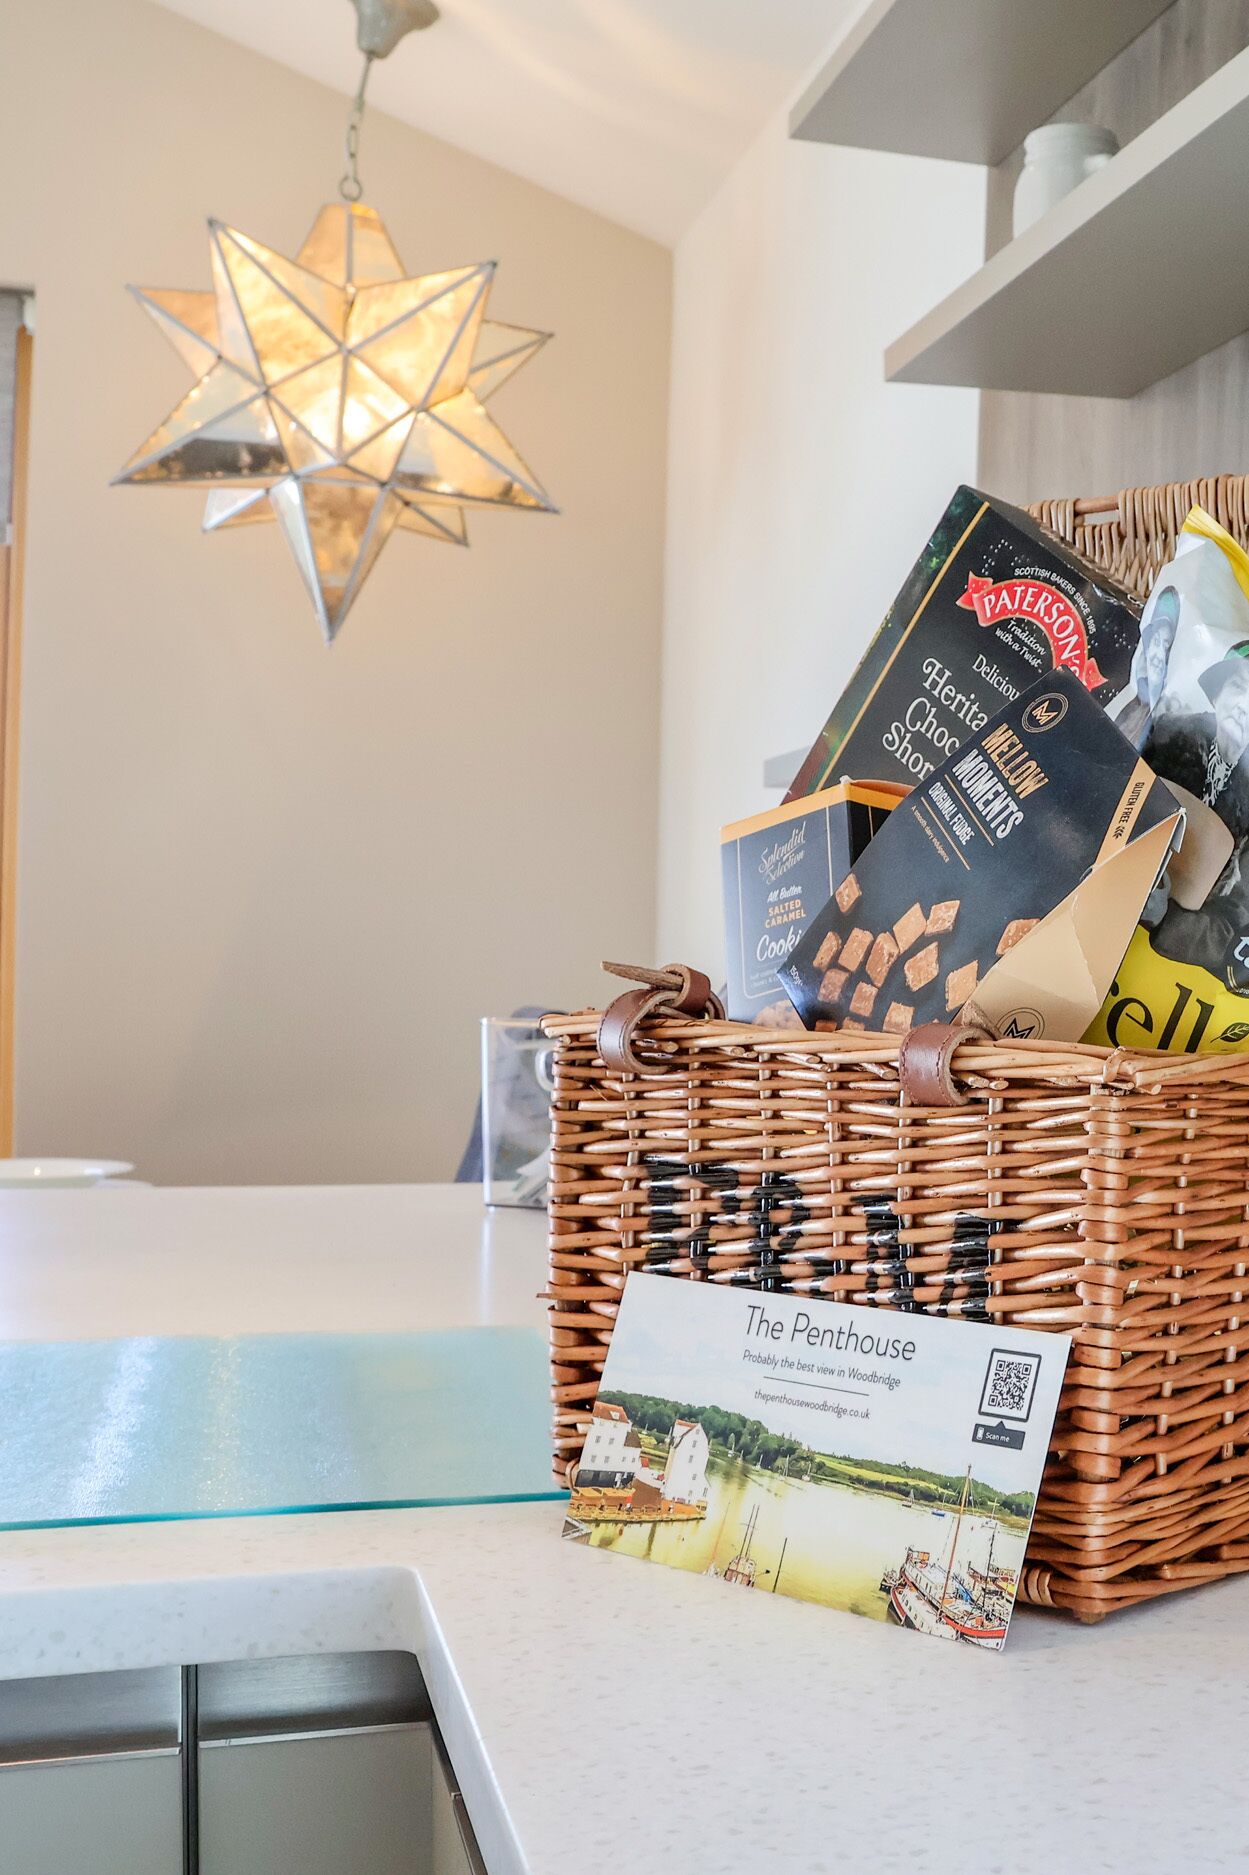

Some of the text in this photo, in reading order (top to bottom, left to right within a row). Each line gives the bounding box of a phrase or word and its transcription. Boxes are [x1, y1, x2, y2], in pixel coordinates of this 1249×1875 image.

[1014, 566, 1097, 635] SCOTTISH BAKERS SINCE 1895
[995, 627, 1014, 646] with
[1011, 642, 1022, 652] a
[1007, 619, 1046, 656] Tradition
[981, 722, 1050, 800] MELLOW
[928, 781, 975, 846] ORIGINAL FUDGE
[952, 748, 1025, 839] MOMENTS
[1118, 781, 1145, 824] GLUTEN FREE
[758, 820, 806, 874] Splendid
[767, 887, 779, 903] All
[768, 898, 802, 917] SALTED
[765, 907, 807, 929] CARAMEL
[1101, 980, 1215, 1053] ell
[746, 1304, 917, 1362] The Penthouse
[742, 1349, 901, 1391] Probably the best view in Woodbridge
[754, 1390, 871, 1420] thepenthousewoodbridge.co.uk
[985, 1431, 1010, 1443] Scan me
